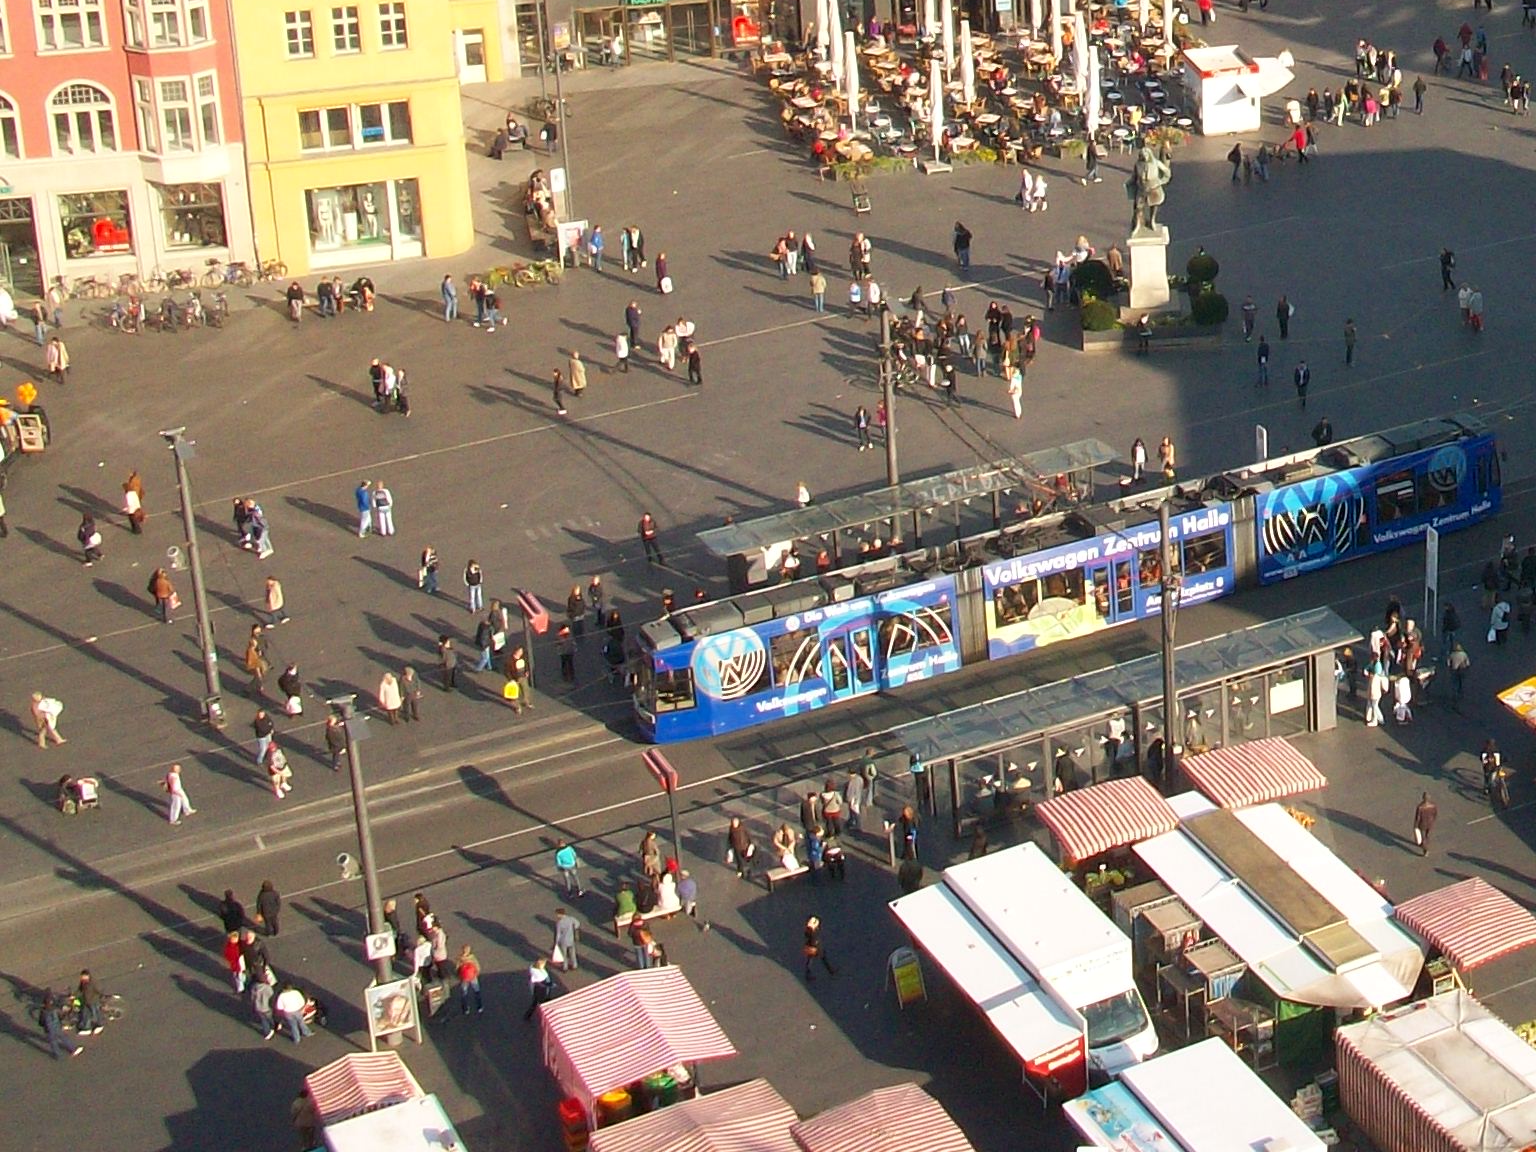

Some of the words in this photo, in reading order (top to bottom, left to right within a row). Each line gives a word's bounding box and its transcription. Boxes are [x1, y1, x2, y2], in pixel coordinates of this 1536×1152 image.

[985, 546, 1100, 586] Volkswagen
[1182, 508, 1230, 536] Halle
[1373, 523, 1431, 544] Volkswagen
[1432, 511, 1470, 528] Zentrum
[1471, 500, 1493, 516] Halle
